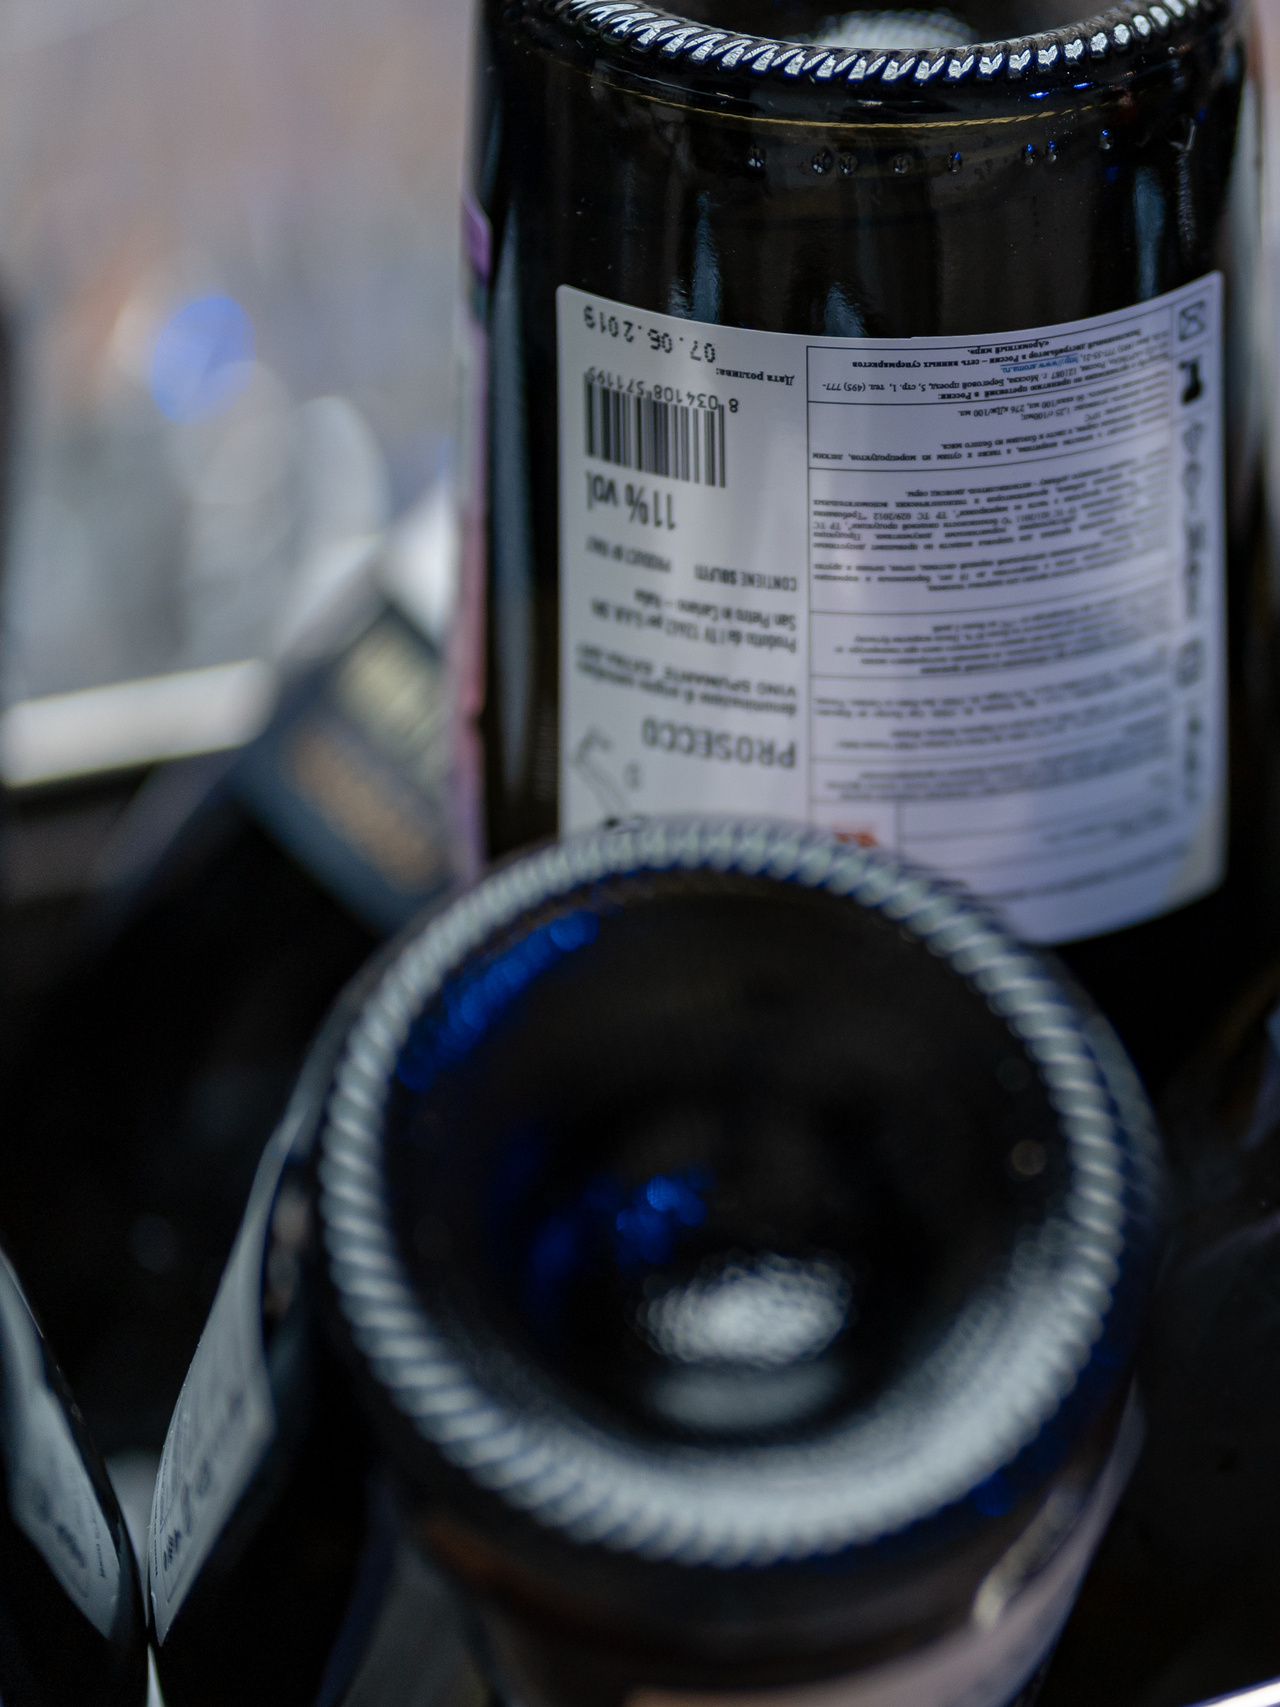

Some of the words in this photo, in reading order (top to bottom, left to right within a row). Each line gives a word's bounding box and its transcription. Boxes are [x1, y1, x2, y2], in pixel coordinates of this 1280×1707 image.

[851, 360, 922, 368] супермаркетов
[922, 360, 958, 368] винных
[988, 354, 1019, 364] России
[716, 366, 764, 382] розлива:
[768, 374, 794, 386] Дата
[821, 382, 842, 392] 777-
[842, 381, 866, 393] (495)
[868, 384, 885, 392] тел.
[888, 383, 898, 392] 1,
[899, 382, 916, 392] стр.
[918, 382, 926, 392] 5,
[652, 384, 718, 411] 034108
[937, 391, 972, 400] России:
[728, 398, 739, 413] 8
[1010, 404, 1024, 414] 276
[585, 471, 619, 511] vol
[624, 482, 676, 532] 11%
[642, 718, 795, 770] PROSECCO
